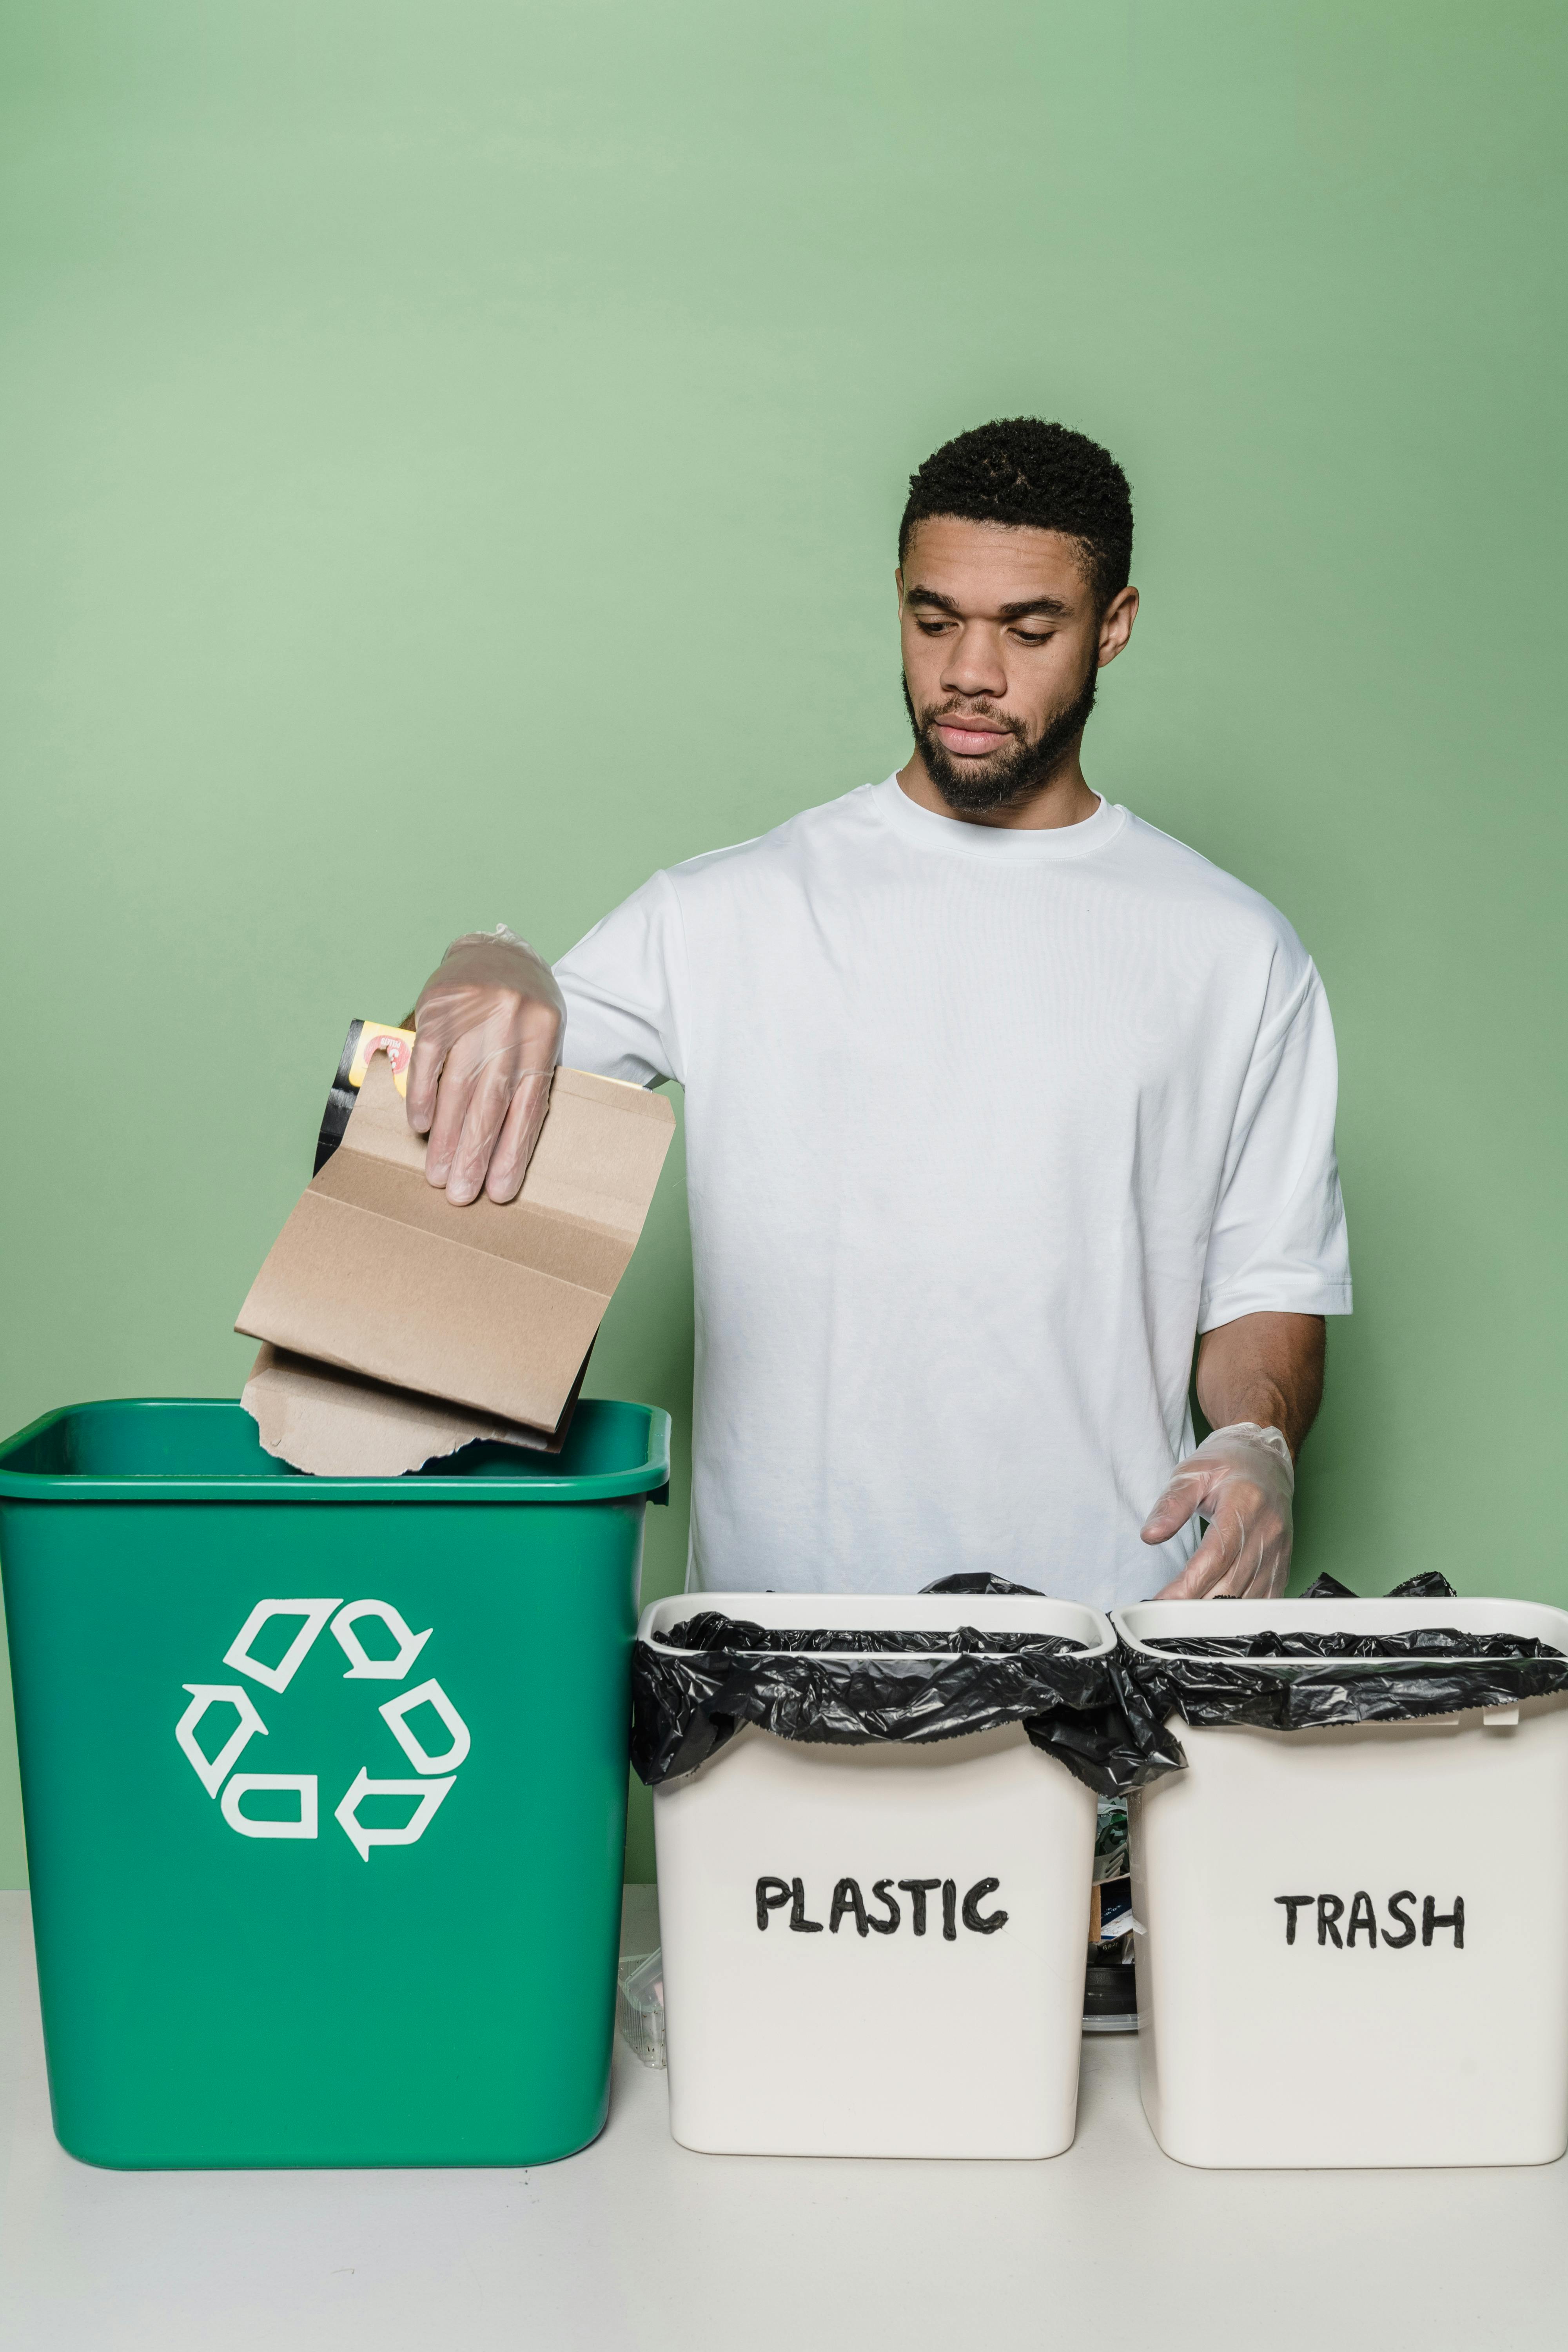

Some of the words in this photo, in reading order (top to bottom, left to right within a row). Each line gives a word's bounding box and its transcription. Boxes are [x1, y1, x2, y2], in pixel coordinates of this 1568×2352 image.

[380, 1037, 401, 1048] PELLETS
[755, 1876, 1009, 1942] PLASTIC
[1274, 1890, 1465, 1950] TRASH
